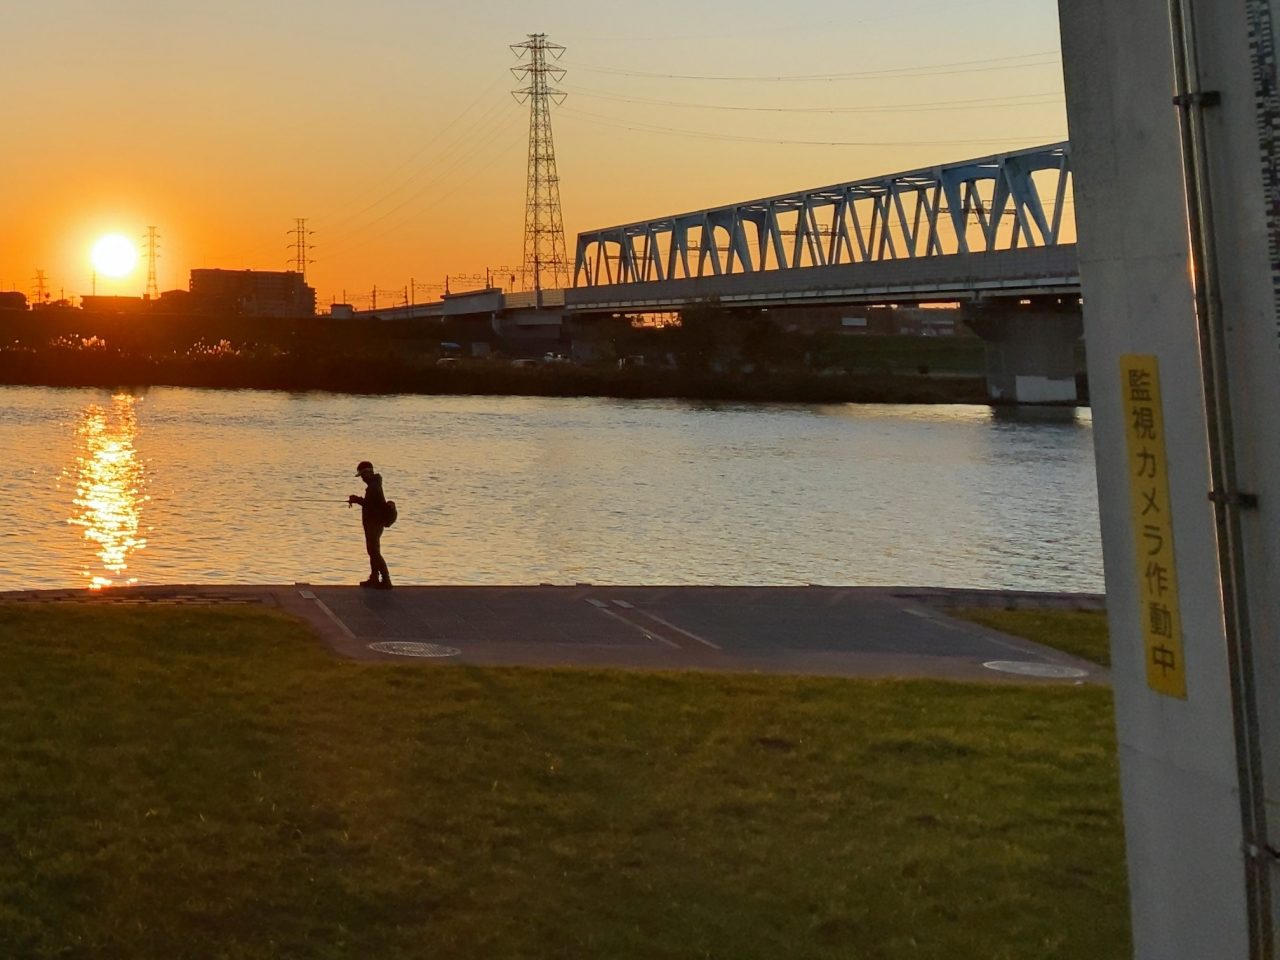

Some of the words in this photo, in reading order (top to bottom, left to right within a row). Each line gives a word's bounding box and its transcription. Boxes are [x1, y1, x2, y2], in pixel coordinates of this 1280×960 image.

[1128, 368, 1176, 677] 監視カメラ作動中
